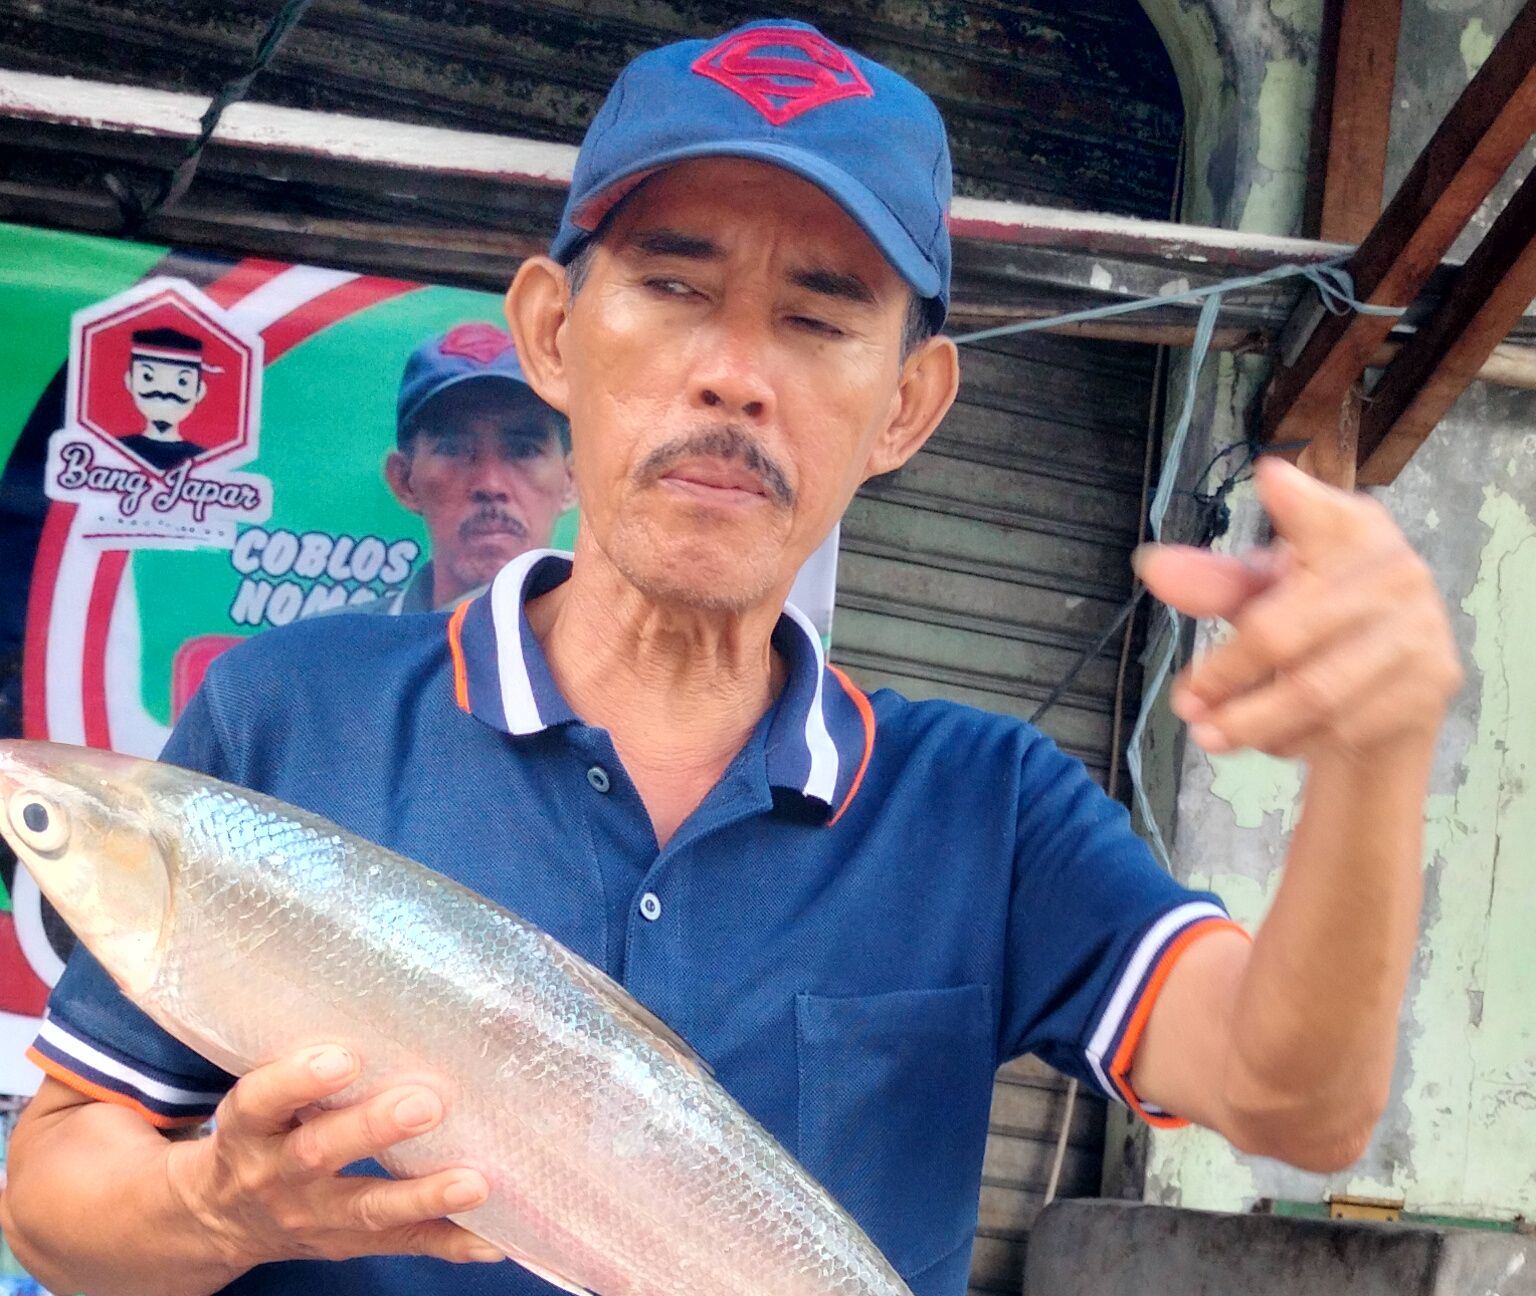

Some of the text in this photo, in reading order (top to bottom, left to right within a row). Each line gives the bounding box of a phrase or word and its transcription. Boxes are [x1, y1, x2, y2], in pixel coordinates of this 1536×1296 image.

[57, 442, 261, 522] Bang Japar
[231, 526, 420, 585] COBLOS
